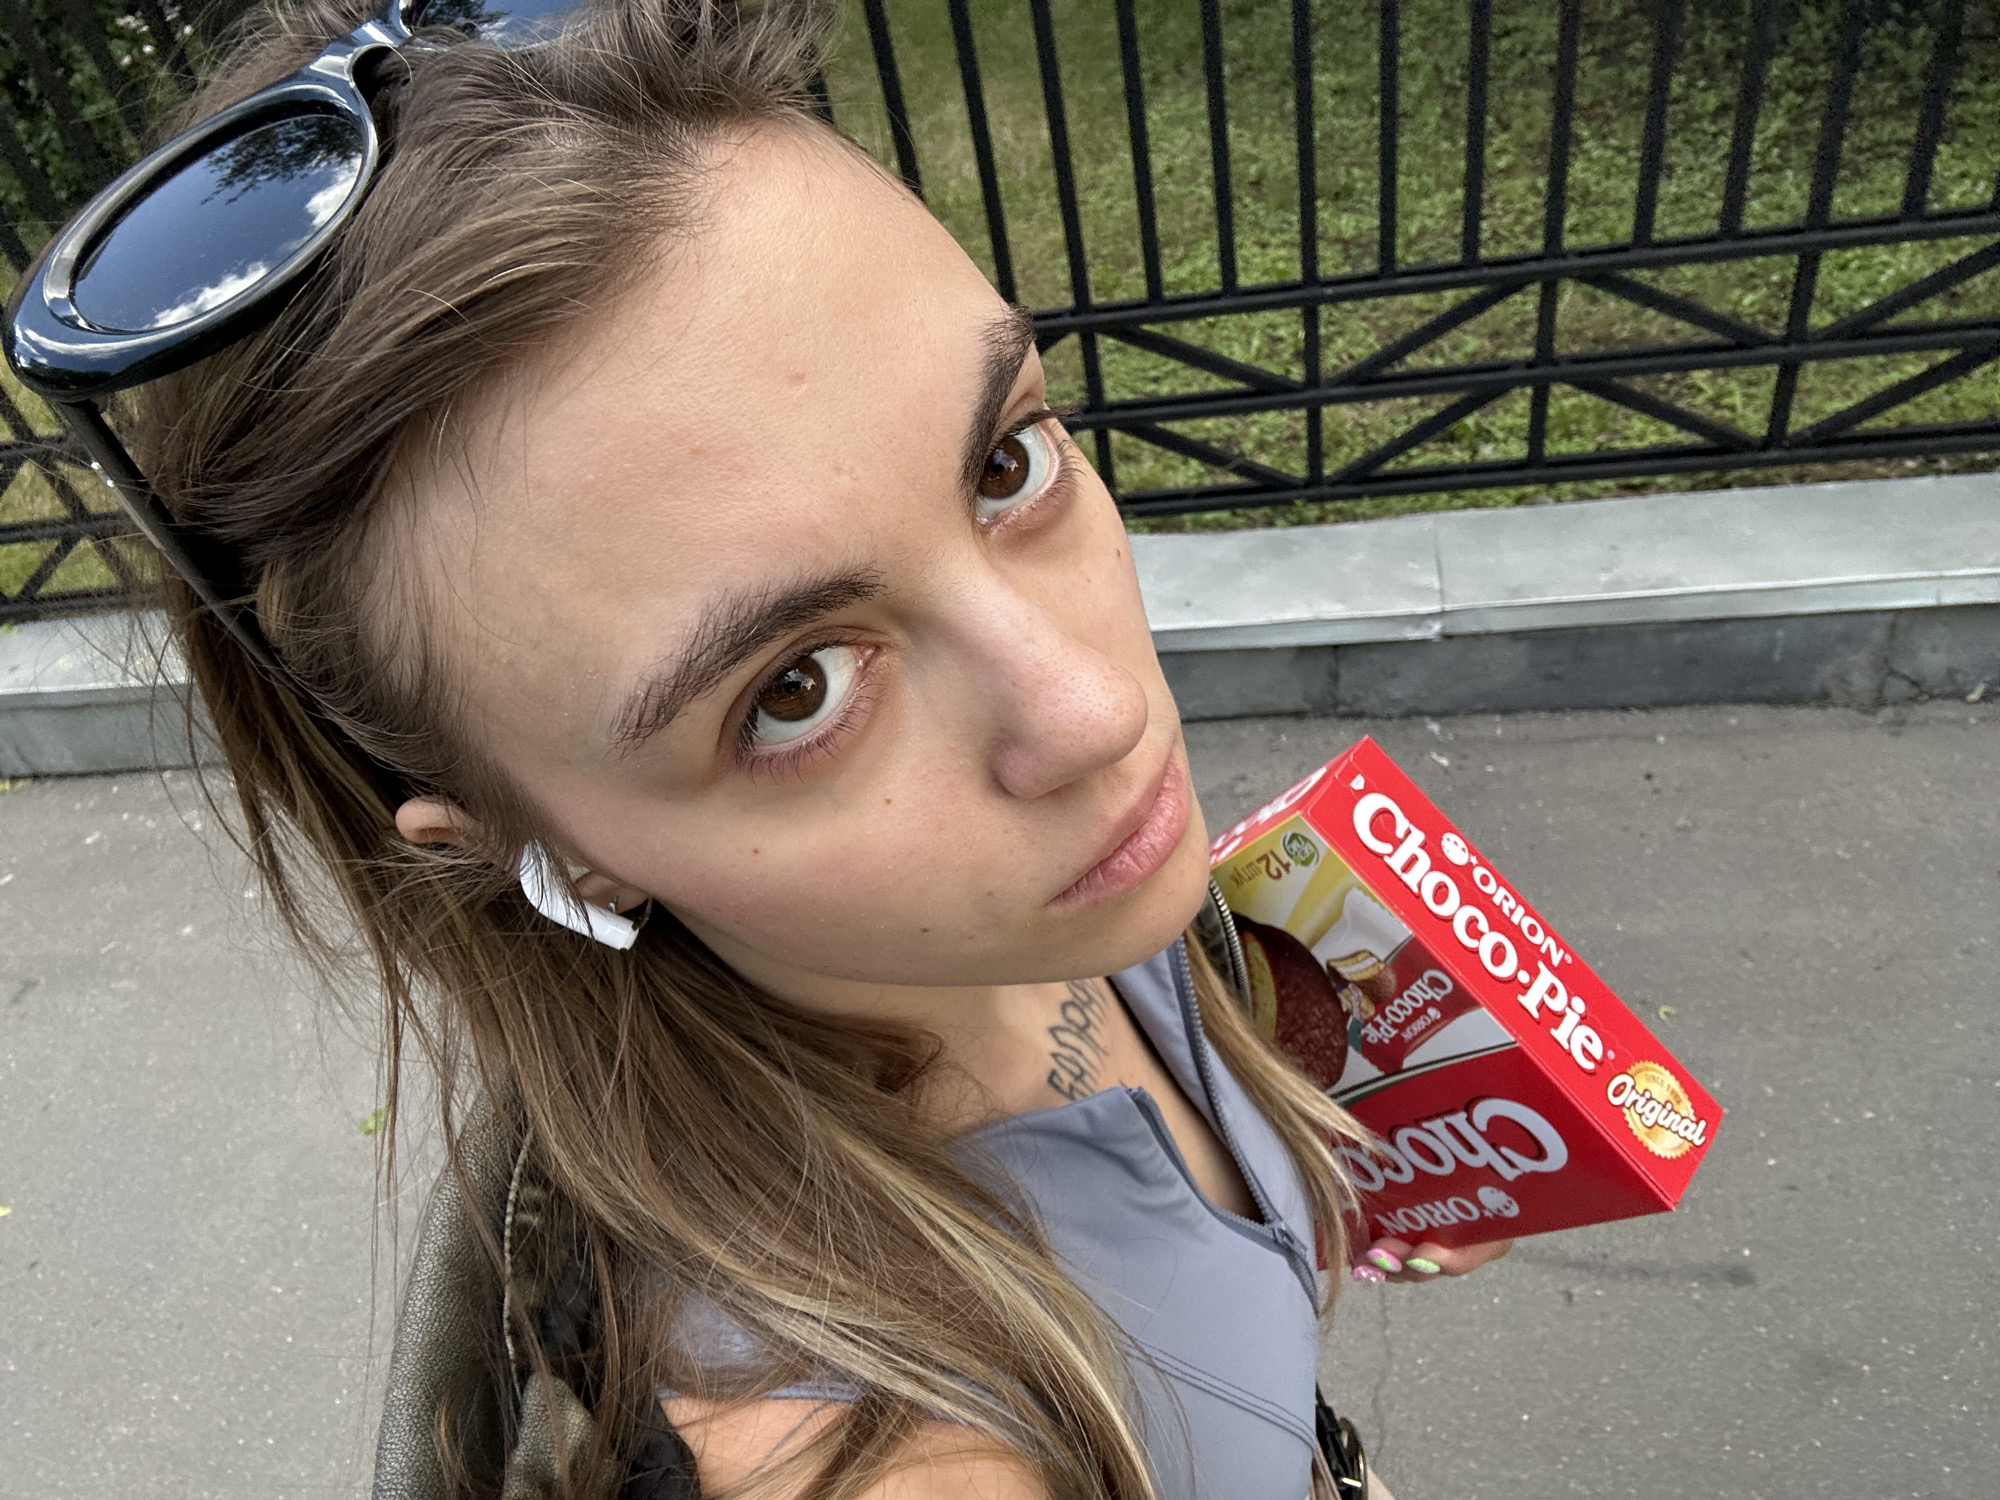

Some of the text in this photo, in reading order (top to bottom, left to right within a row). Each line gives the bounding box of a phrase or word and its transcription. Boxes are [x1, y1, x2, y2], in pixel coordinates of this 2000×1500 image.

[1256, 850, 1291, 880] 12
[1606, 1073, 1707, 1148] Original
[1376, 1196, 1480, 1235] ORION
